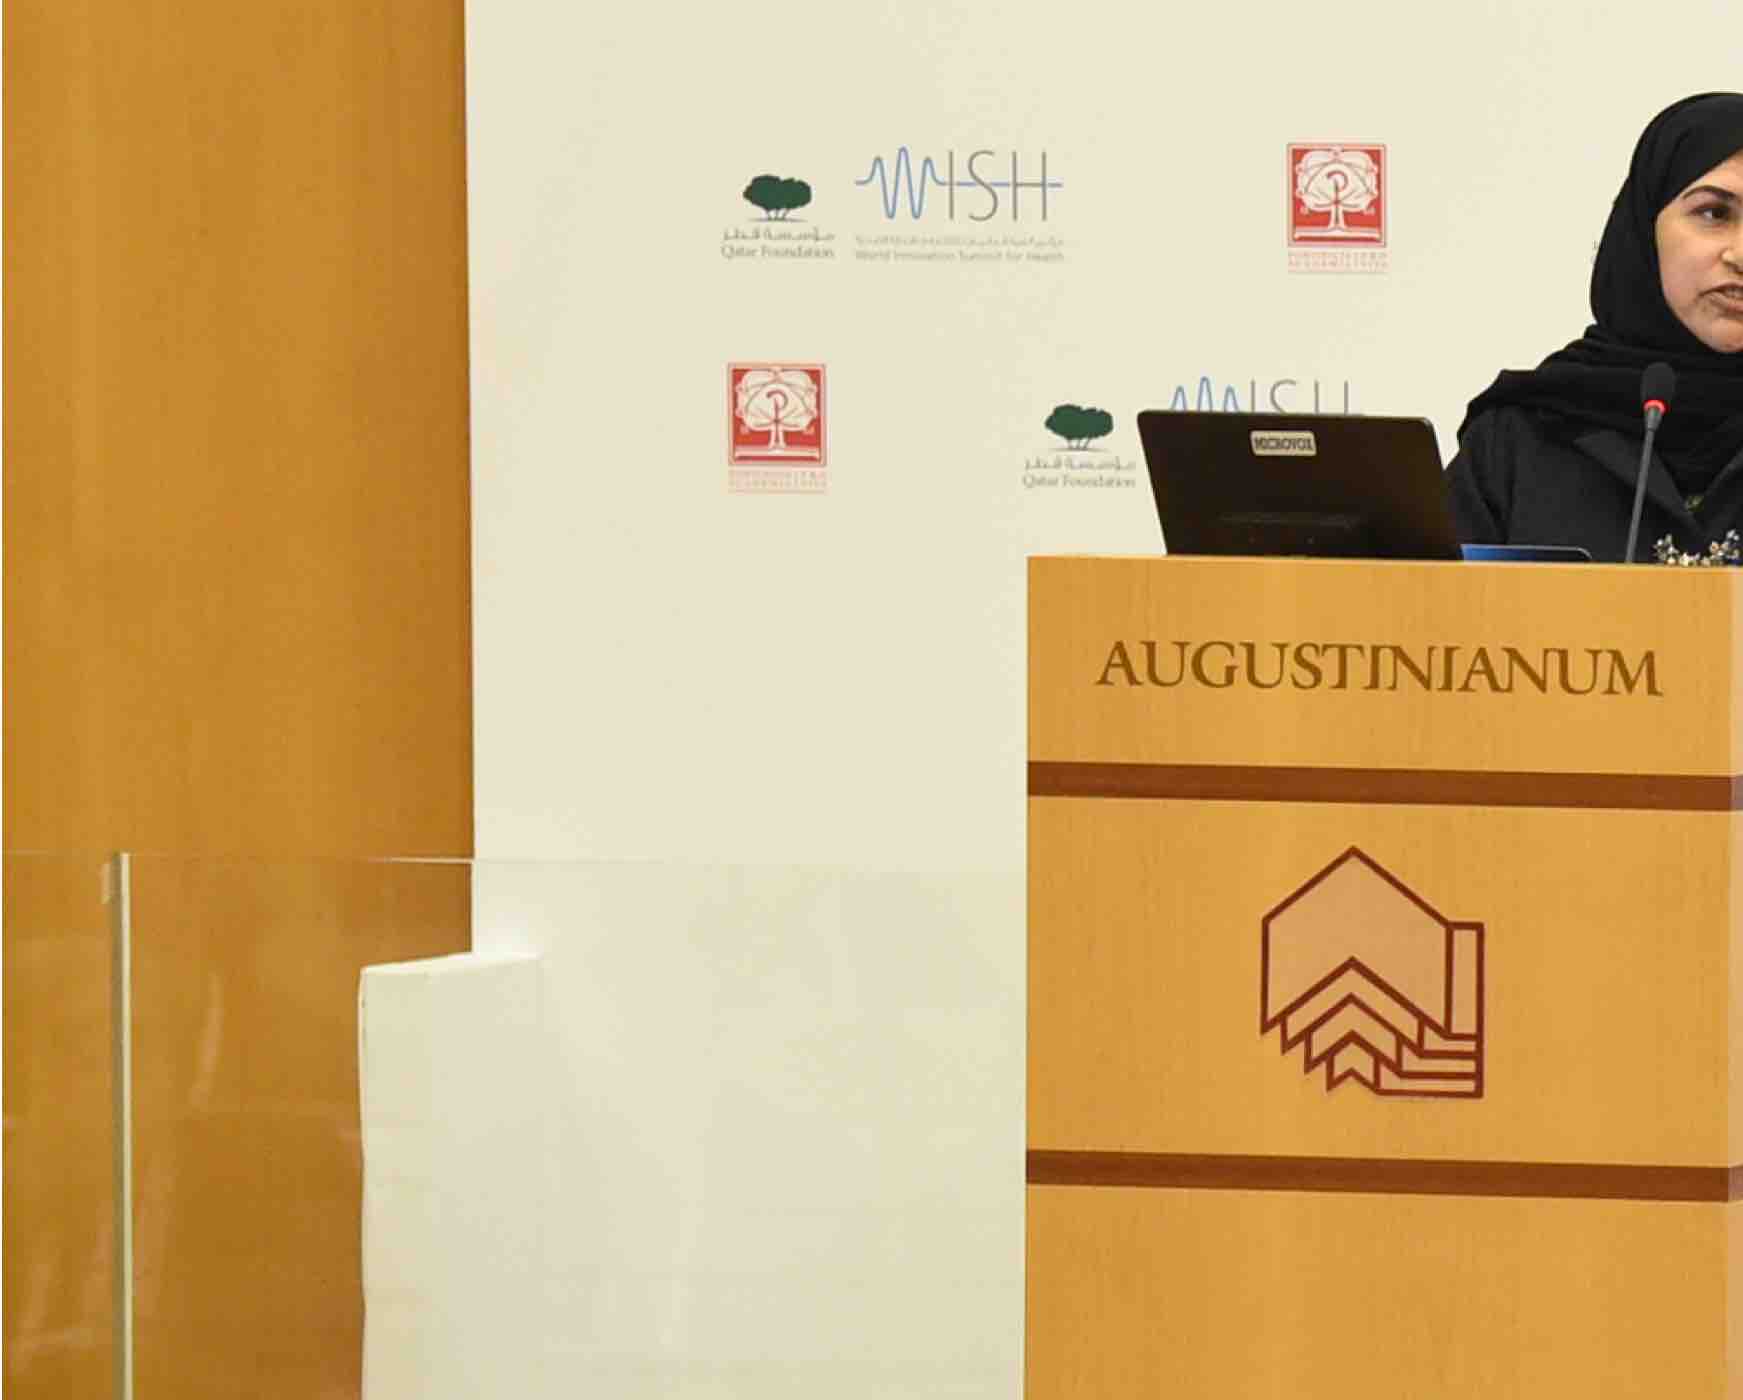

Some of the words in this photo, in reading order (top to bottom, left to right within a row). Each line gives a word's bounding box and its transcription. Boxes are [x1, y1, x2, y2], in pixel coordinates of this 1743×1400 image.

[854, 146, 1063, 222] WISH
[721, 244, 757, 262] Qatar
[761, 244, 834, 262] Foundation
[1022, 473, 1058, 491] Qatar
[1062, 473, 1135, 491] Foundation
[1096, 640, 1664, 697] AUGUSTINIANUM
